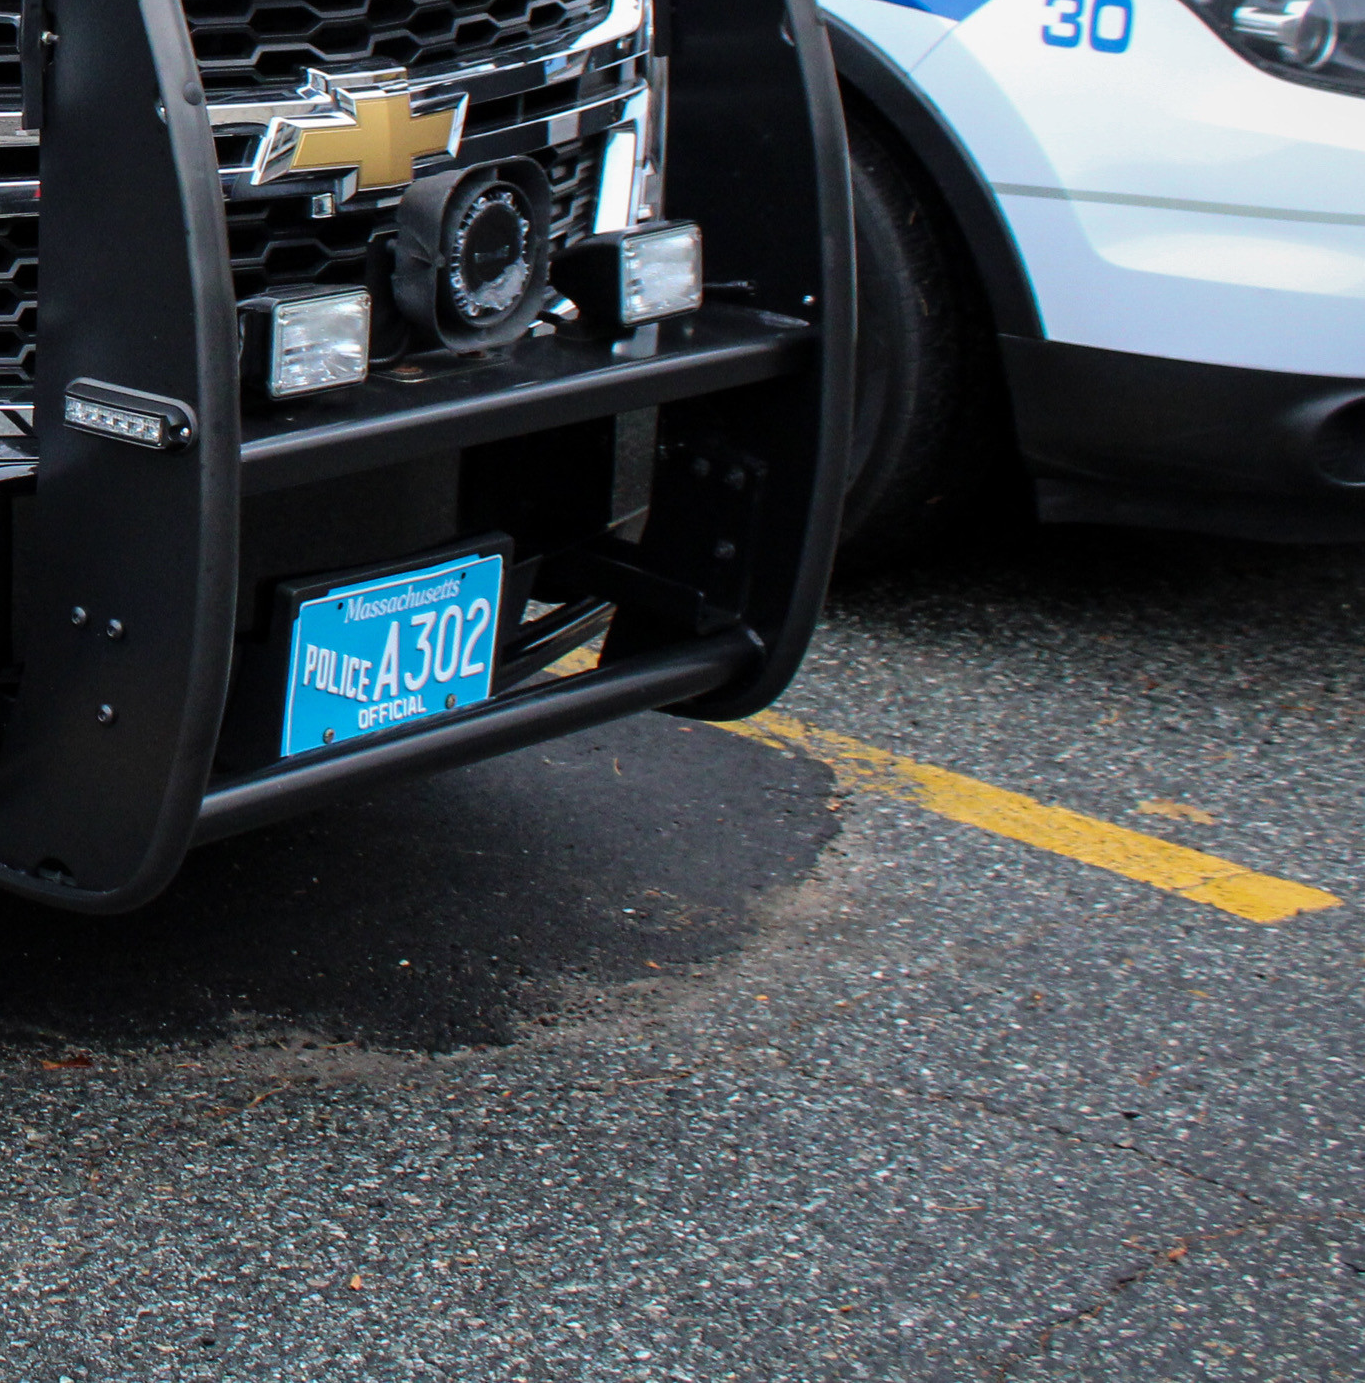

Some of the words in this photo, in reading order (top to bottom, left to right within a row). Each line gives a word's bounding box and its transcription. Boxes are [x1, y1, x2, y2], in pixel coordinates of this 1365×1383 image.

[344, 579, 462, 624] Massachusetts
[303, 644, 373, 703] POLICE
[372, 598, 491, 702] A302
[358, 694, 427, 731] OFFICIAL
